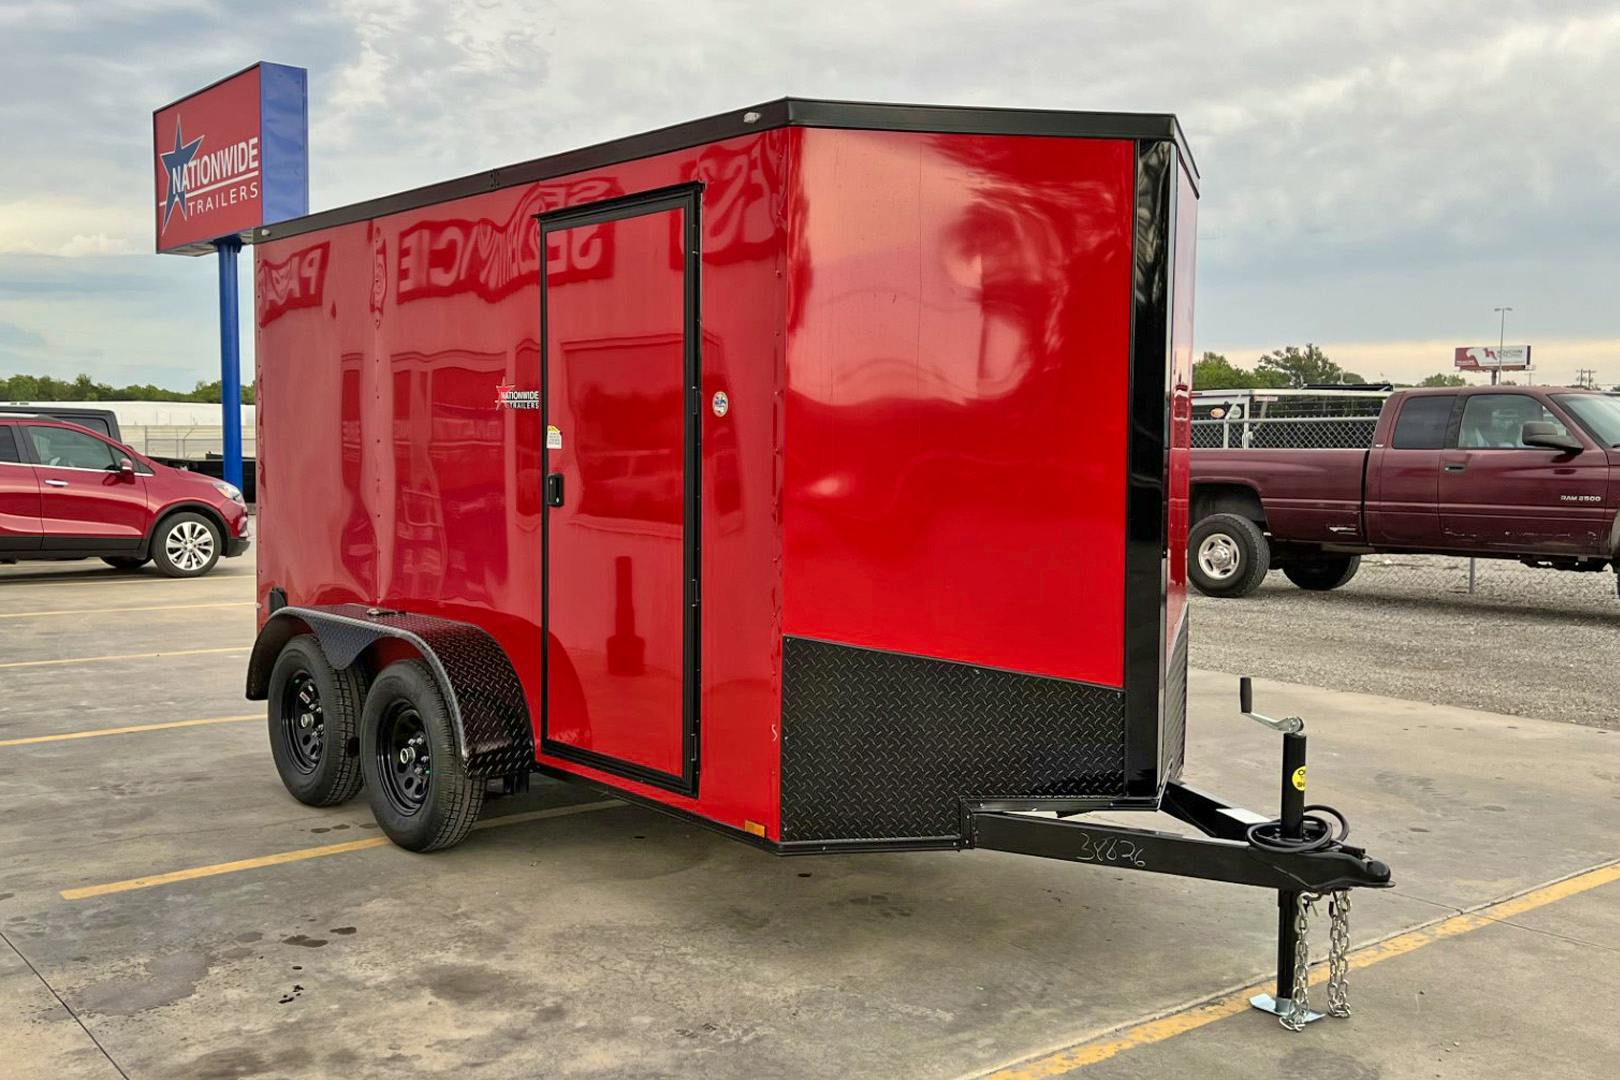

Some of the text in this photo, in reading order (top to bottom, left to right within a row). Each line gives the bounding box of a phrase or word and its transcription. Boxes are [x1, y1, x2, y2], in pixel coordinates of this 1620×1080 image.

[172, 137, 259, 194] NATIONWIDE
[187, 182, 259, 216] TRAILERS
[500, 391, 539, 400] NATIONWIDE
